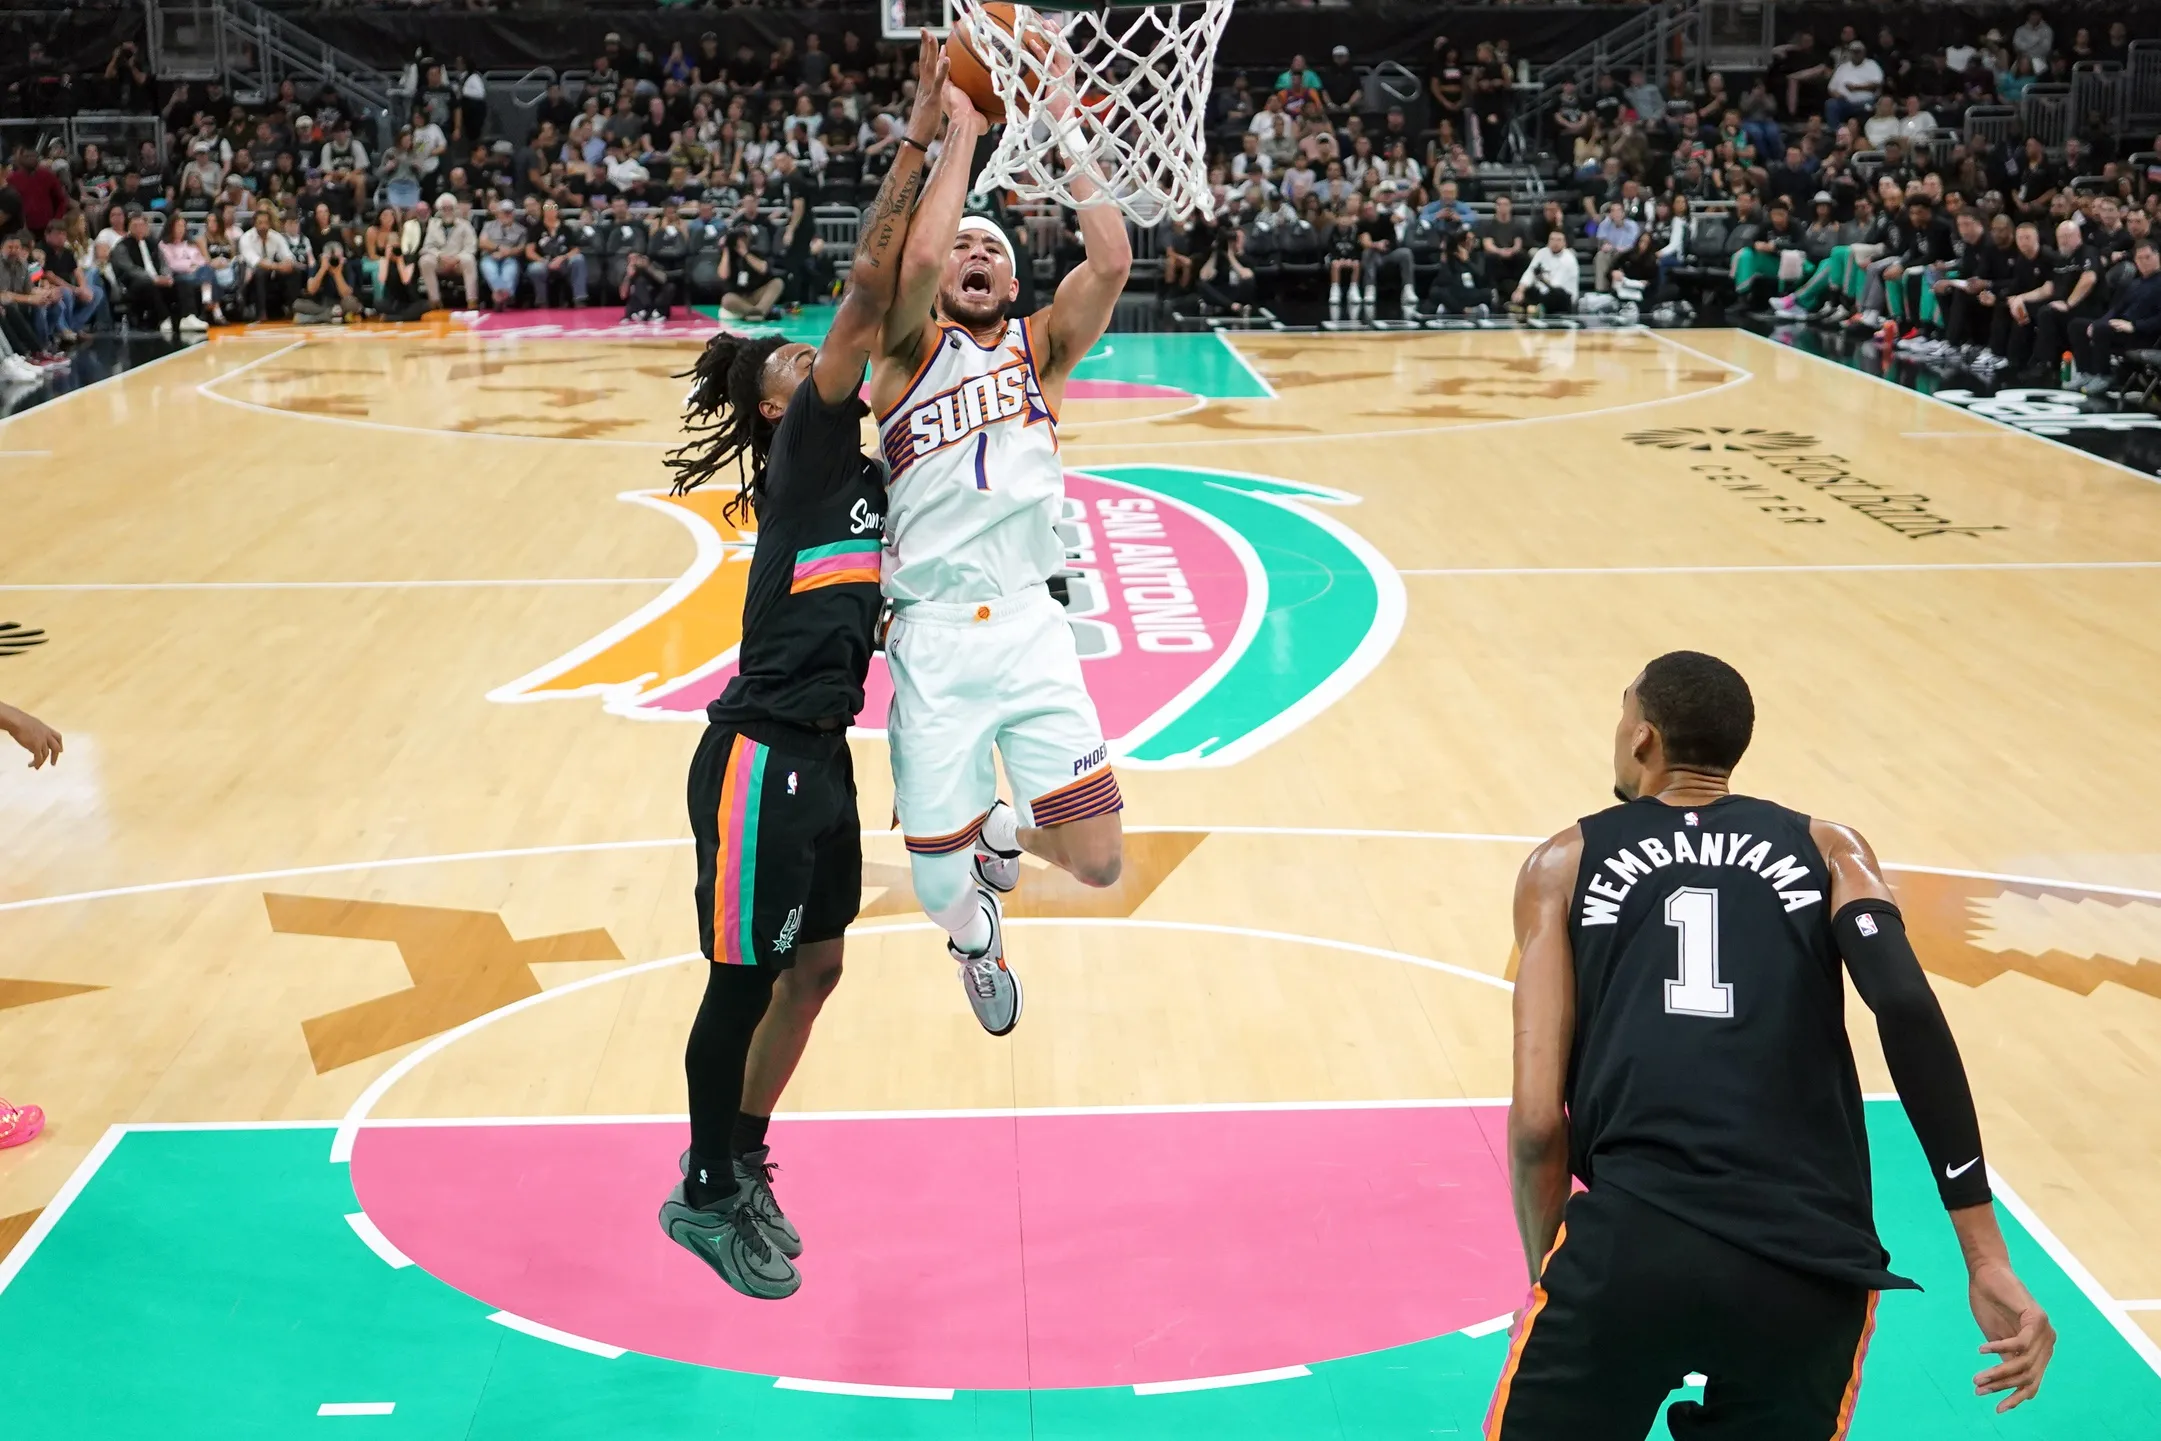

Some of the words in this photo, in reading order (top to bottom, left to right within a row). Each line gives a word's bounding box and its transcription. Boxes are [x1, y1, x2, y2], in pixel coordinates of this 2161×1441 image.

[910, 364, 1026, 456] SUNS
[973, 432, 992, 491] 1
[1690, 464, 1828, 525] CENTER
[850, 497, 880, 535] San
[1096, 498, 1167, 539] SAN
[1110, 545, 1214, 653] ANTONIO
[1581, 831, 1823, 927] WEMBANYAMA
[1663, 886, 1734, 1018] 1
